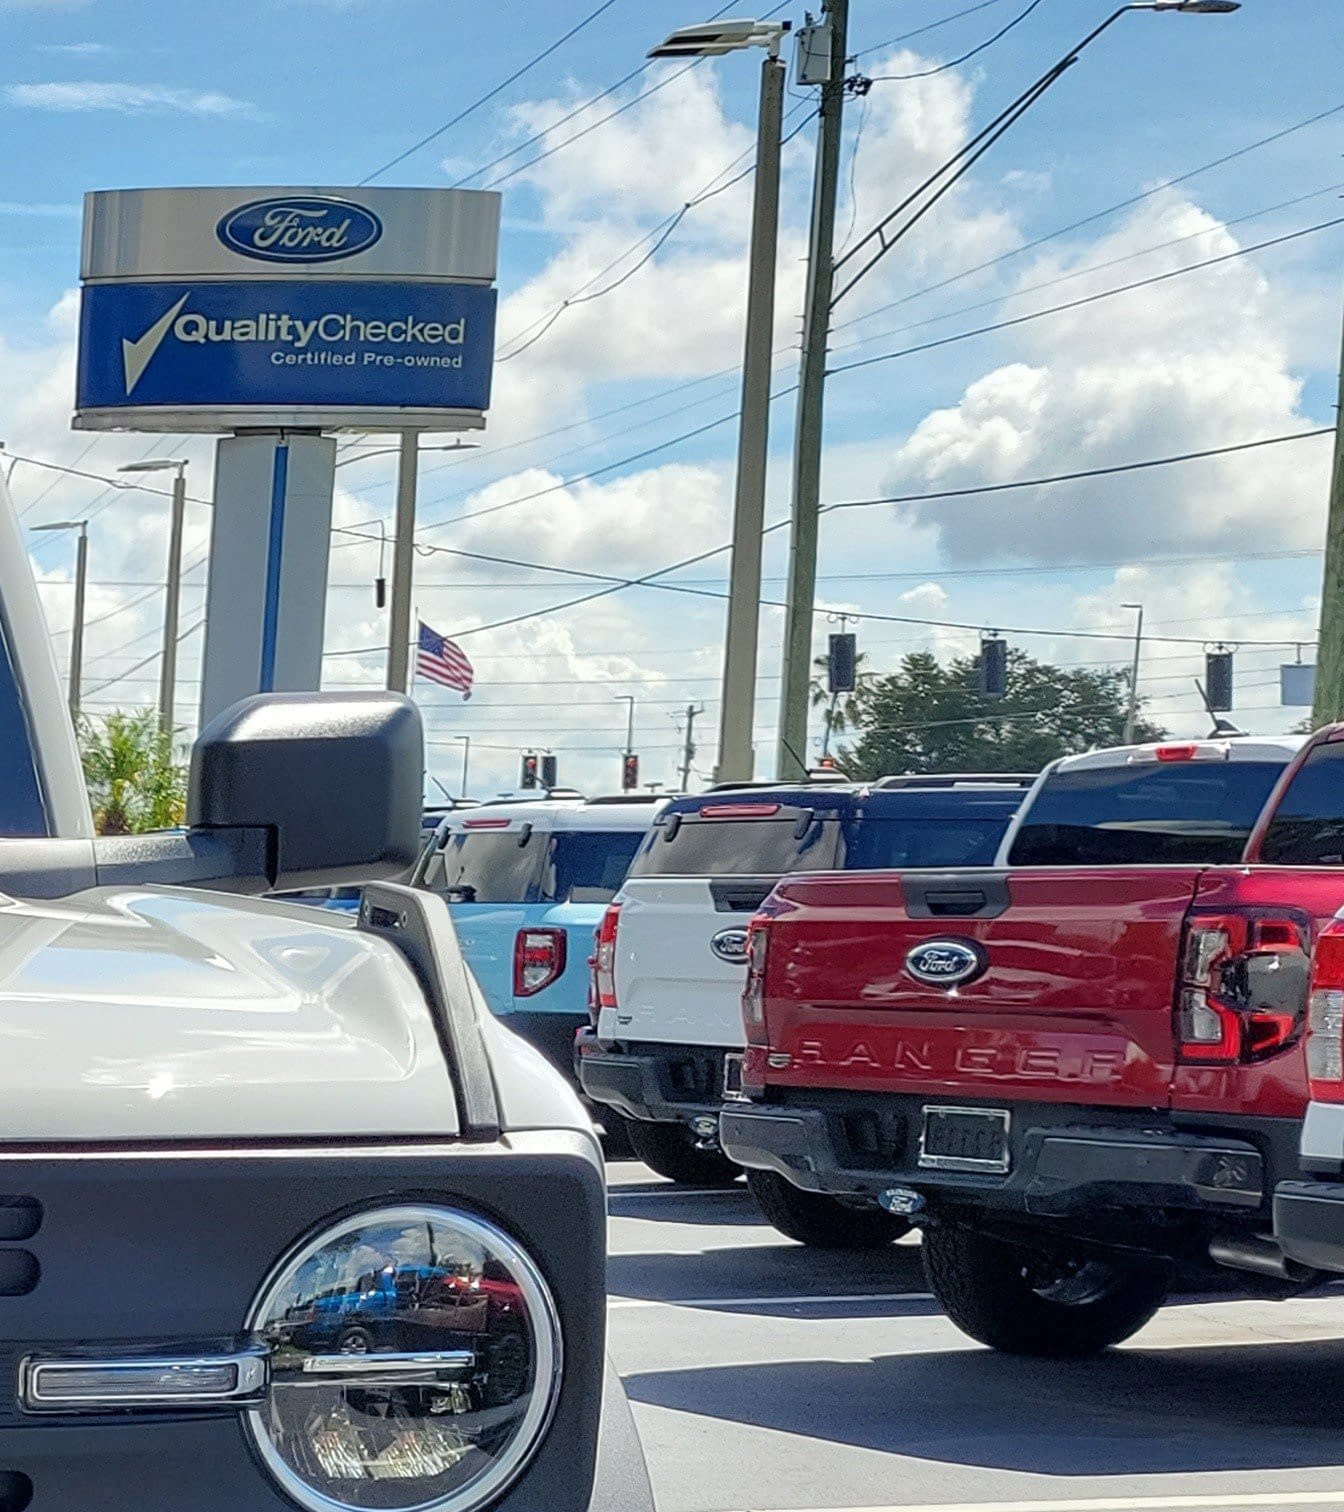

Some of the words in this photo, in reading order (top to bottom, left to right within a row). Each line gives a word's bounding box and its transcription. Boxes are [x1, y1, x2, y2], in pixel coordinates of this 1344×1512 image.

[252, 207, 352, 248] Ford
[270, 350, 356, 366] Certified
[363, 352, 463, 368] Pre-owned
[919, 950, 958, 972] Ford
[792, 1041, 1127, 1080] RANGER
